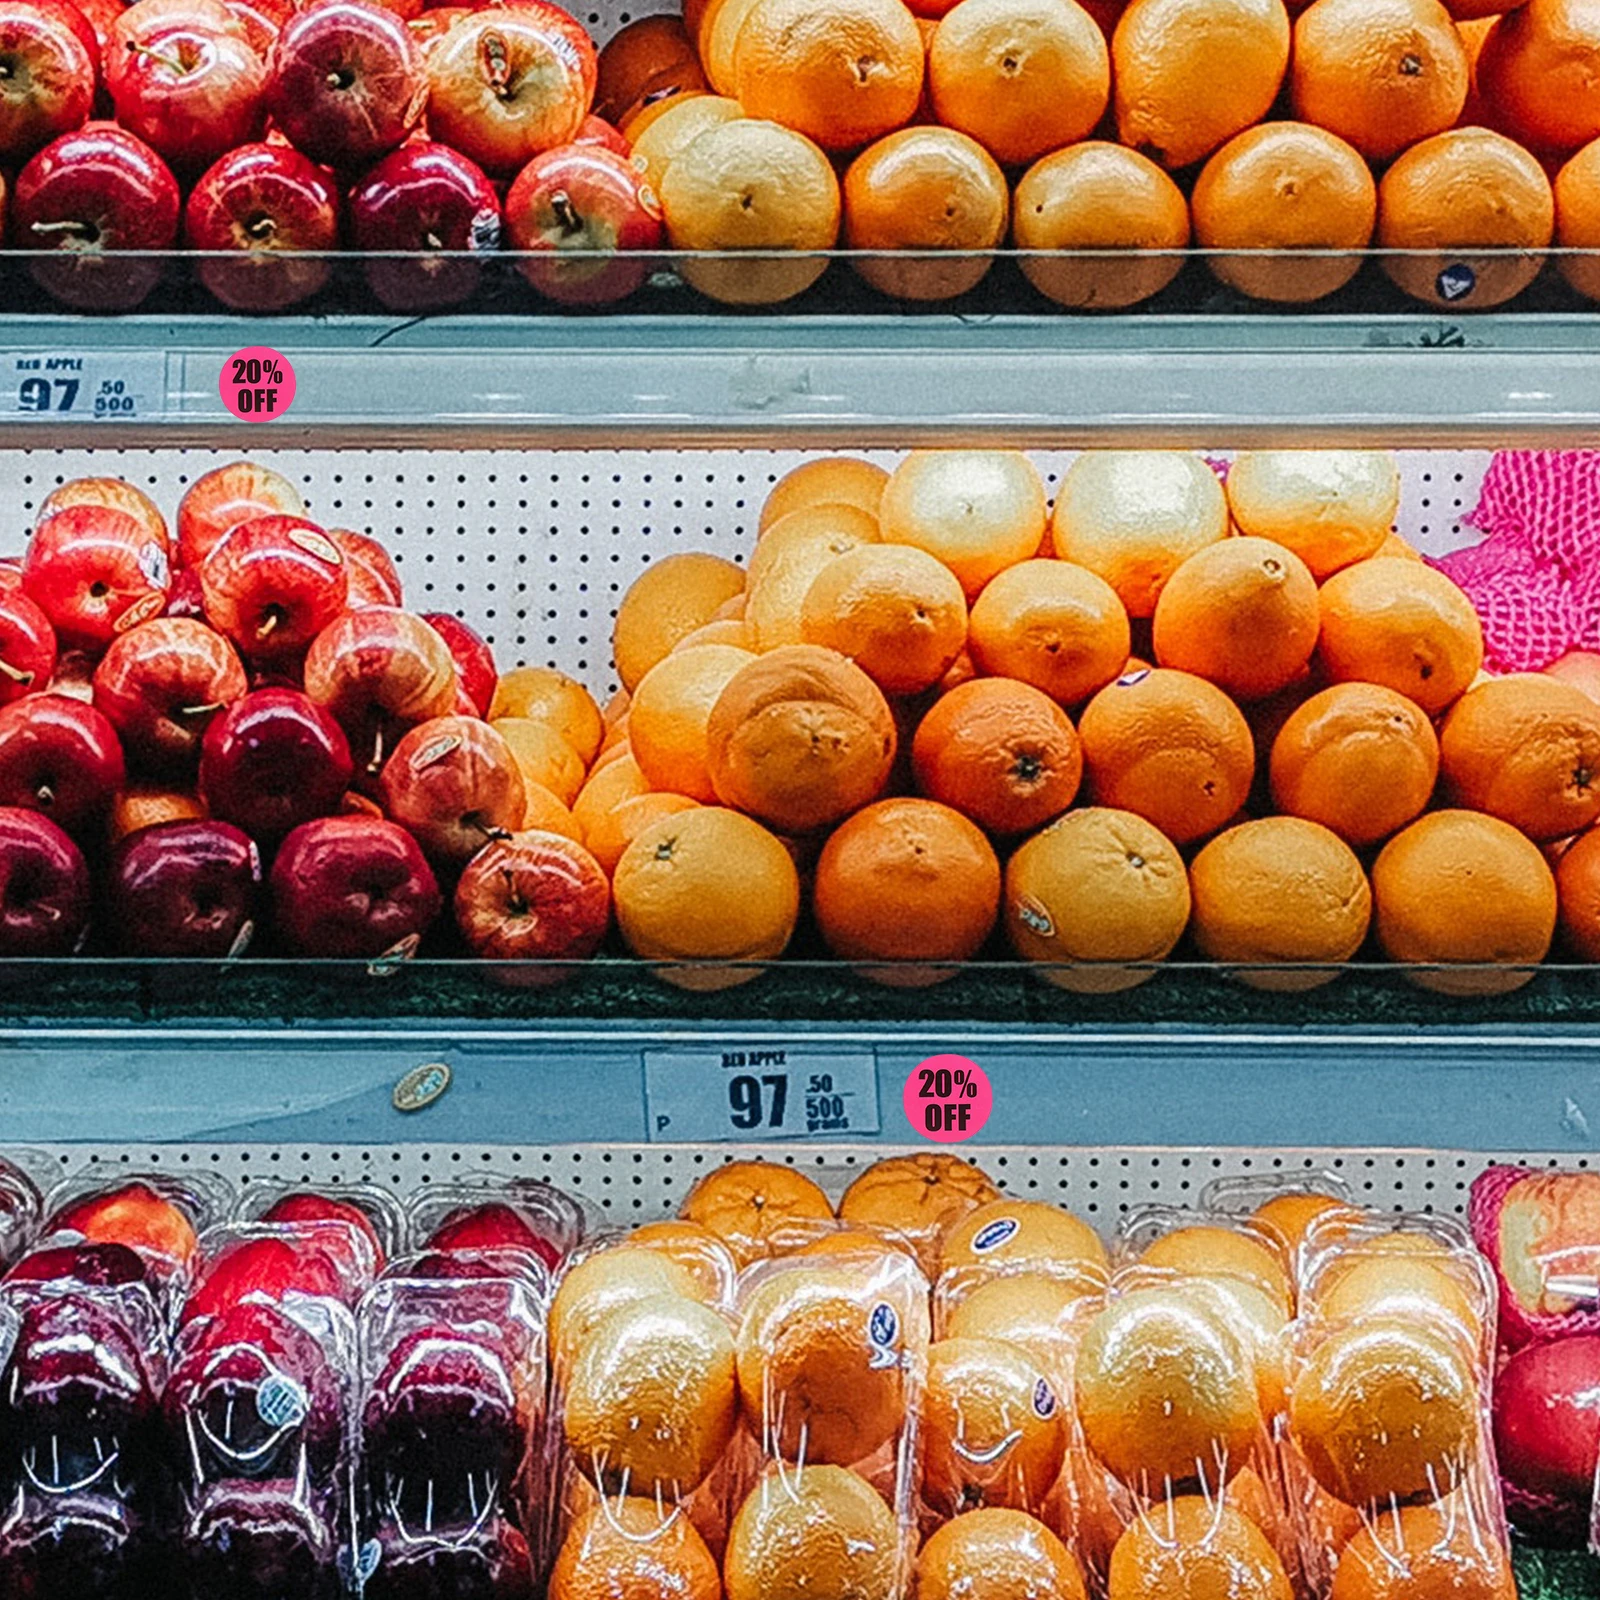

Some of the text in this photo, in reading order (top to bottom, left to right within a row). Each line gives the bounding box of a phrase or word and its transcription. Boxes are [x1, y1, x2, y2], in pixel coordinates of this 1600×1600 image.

[18, 377, 80, 411] 97
[95, 397, 134, 411] 500
[729, 1074, 788, 1129] 97
[806, 1096, 844, 1118] 500
[656, 1115, 671, 1133] P
